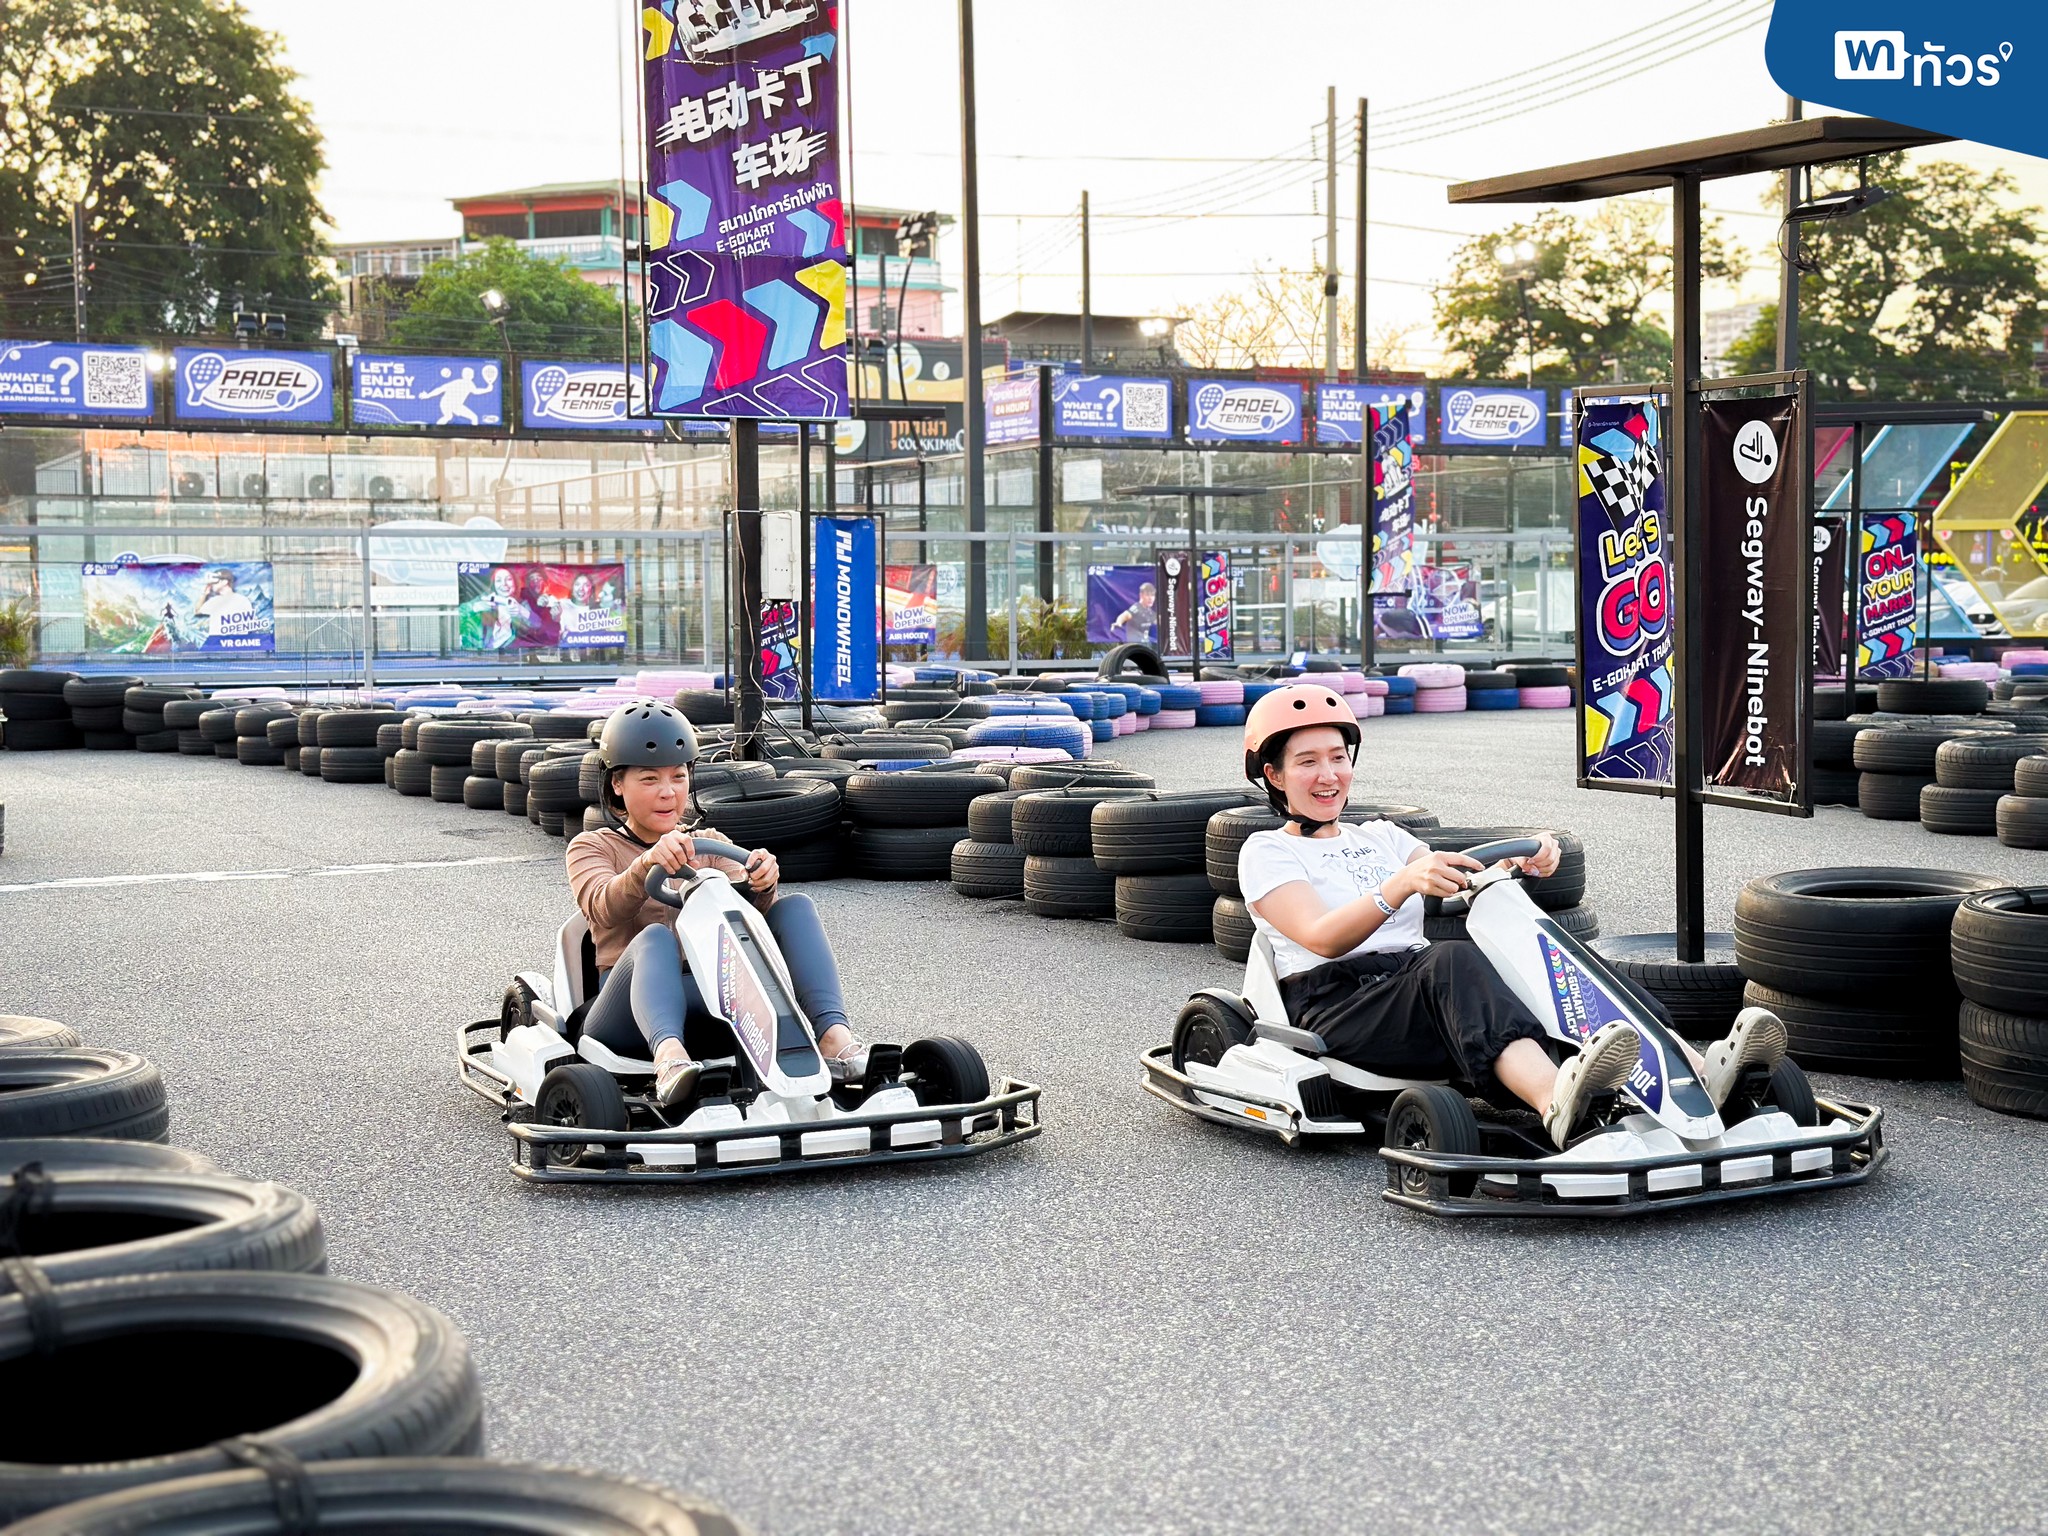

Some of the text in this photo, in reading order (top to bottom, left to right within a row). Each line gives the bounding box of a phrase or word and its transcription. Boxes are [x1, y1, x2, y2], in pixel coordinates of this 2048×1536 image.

[666, 55, 822, 145] 电动卡丁
[732, 126, 814, 189] 车场
[718, 183, 833, 234] สนามโกคาร์ทไฟฟ้า
[716, 221, 775, 253] E-GOKART
[731, 238, 771, 261] TRACK
[360, 361, 406, 375] LET'S
[0, 372, 55, 383] WHAT IS
[220, 370, 308, 388] PADEL
[360, 375, 415, 388] ENJOY
[0, 383, 56, 395] PADEL
[217, 388, 276, 400] TENNIS
[360, 387, 416, 400] PADEL
[563, 382, 642, 398] PADEL
[1321, 389, 1356, 400] LET'S
[561, 399, 613, 411] TENNIS
[1062, 401, 1103, 411] WHAT IS
[1221, 399, 1283, 413] PADEL
[1321, 400, 1363, 410] ENJOY
[1471, 405, 1529, 418] PADEL
[1062, 410, 1104, 421] PADEL
[1219, 413, 1260, 424] TENNIS
[1321, 410, 1363, 421] PADEL
[1469, 418, 1508, 429] TENNIS
[1604, 515, 1659, 572] Let's
[1865, 570, 1913, 600] YOUR
[1602, 559, 1667, 645] GO
[1865, 592, 1913, 621] MARKS
[220, 610, 256, 625] NOW
[578, 608, 610, 622] NOW
[894, 607, 923, 621] NOW
[1167, 578, 1178, 651] Segway-Ninebot
[1444, 605, 1468, 616] NOW
[578, 618, 622, 631] OPENING
[837, 563, 852, 688] MONOWHEEL
[894, 616, 932, 629] OPENING
[1443, 612, 1478, 625] OPENING
[220, 619, 269, 635] OPENING
[1438, 625, 1479, 633] BASKETBALL
[1741, 496, 1769, 768] Segway-Ninebot
[1862, 622, 1895, 640] E-GOKART
[220, 639, 261, 648] VR GAME
[567, 634, 625, 644] GAME CONSOLE
[1592, 652, 1650, 693] E-GOKART
[722, 979, 731, 1015] TRACK
[1564, 962, 1586, 1021] E-GOKART
[1561, 997, 1579, 1037] TRACK
[740, 1010, 770, 1063] ninebot
